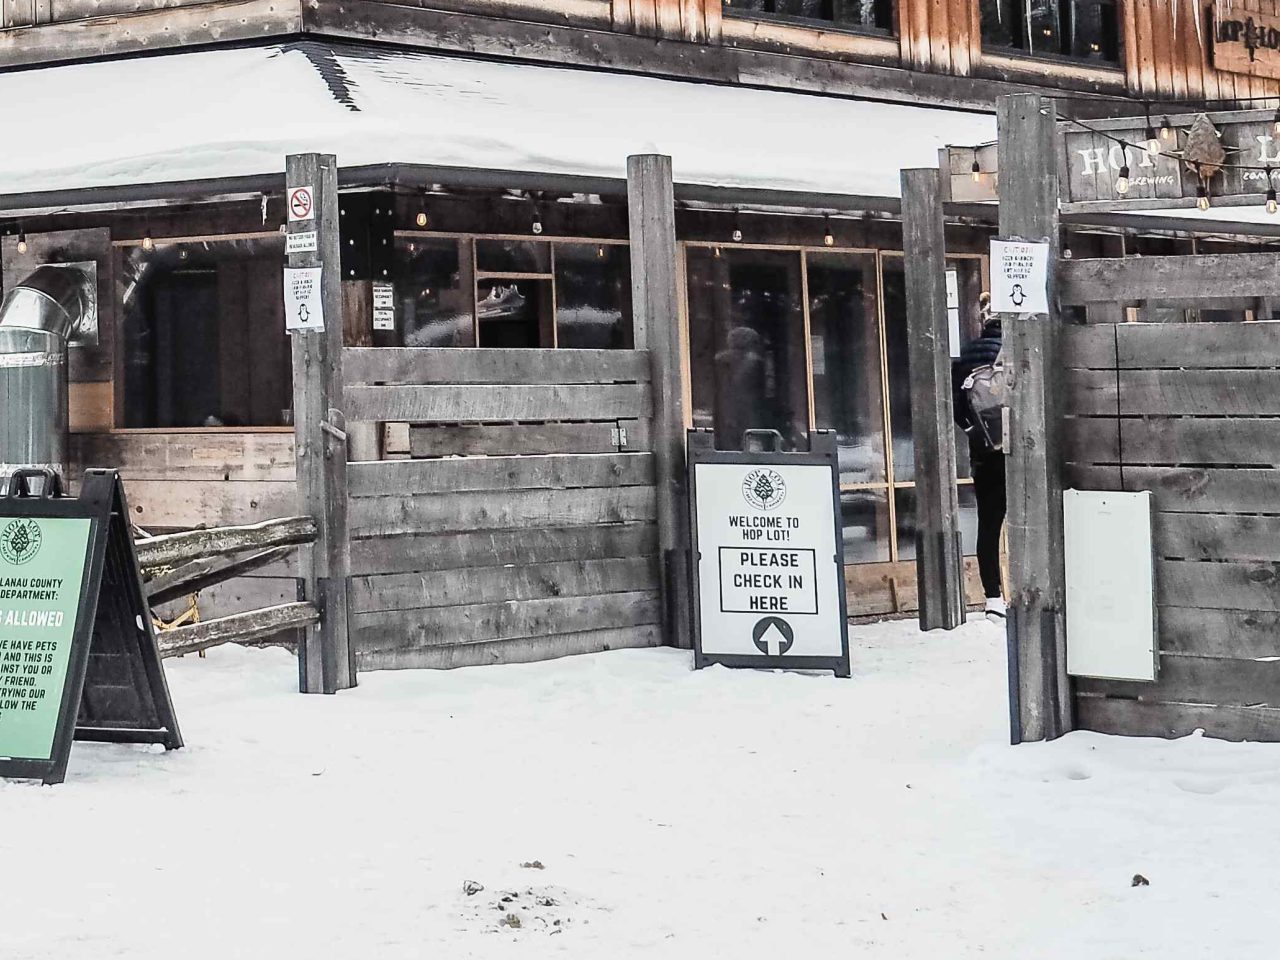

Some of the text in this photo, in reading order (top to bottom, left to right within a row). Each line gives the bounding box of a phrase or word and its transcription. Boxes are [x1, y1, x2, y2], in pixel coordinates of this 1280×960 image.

[729, 516, 799, 528] WELCOME TO
[742, 529, 790, 541] HOP LOT!
[740, 552, 799, 567] PLEASE
[30, 579, 63, 589] COUNTY
[733, 574, 803, 589] CHECK IN
[0, 589, 59, 600] DEPARTMENT:
[750, 596, 788, 611] HERE
[5, 610, 64, 627] ALLOWED
[10, 640, 33, 650] HAVE
[35, 641, 57, 651] PETS
[3, 652, 21, 662] AND
[24, 653, 42, 662] THIS
[44, 653, 53, 663] IS
[22, 664, 39, 674] YOU
[41, 665, 53, 675] OR
[4, 676, 37, 687] FRIEND.
[29, 689, 46, 699] OUR
[21, 701, 37, 710] THE
